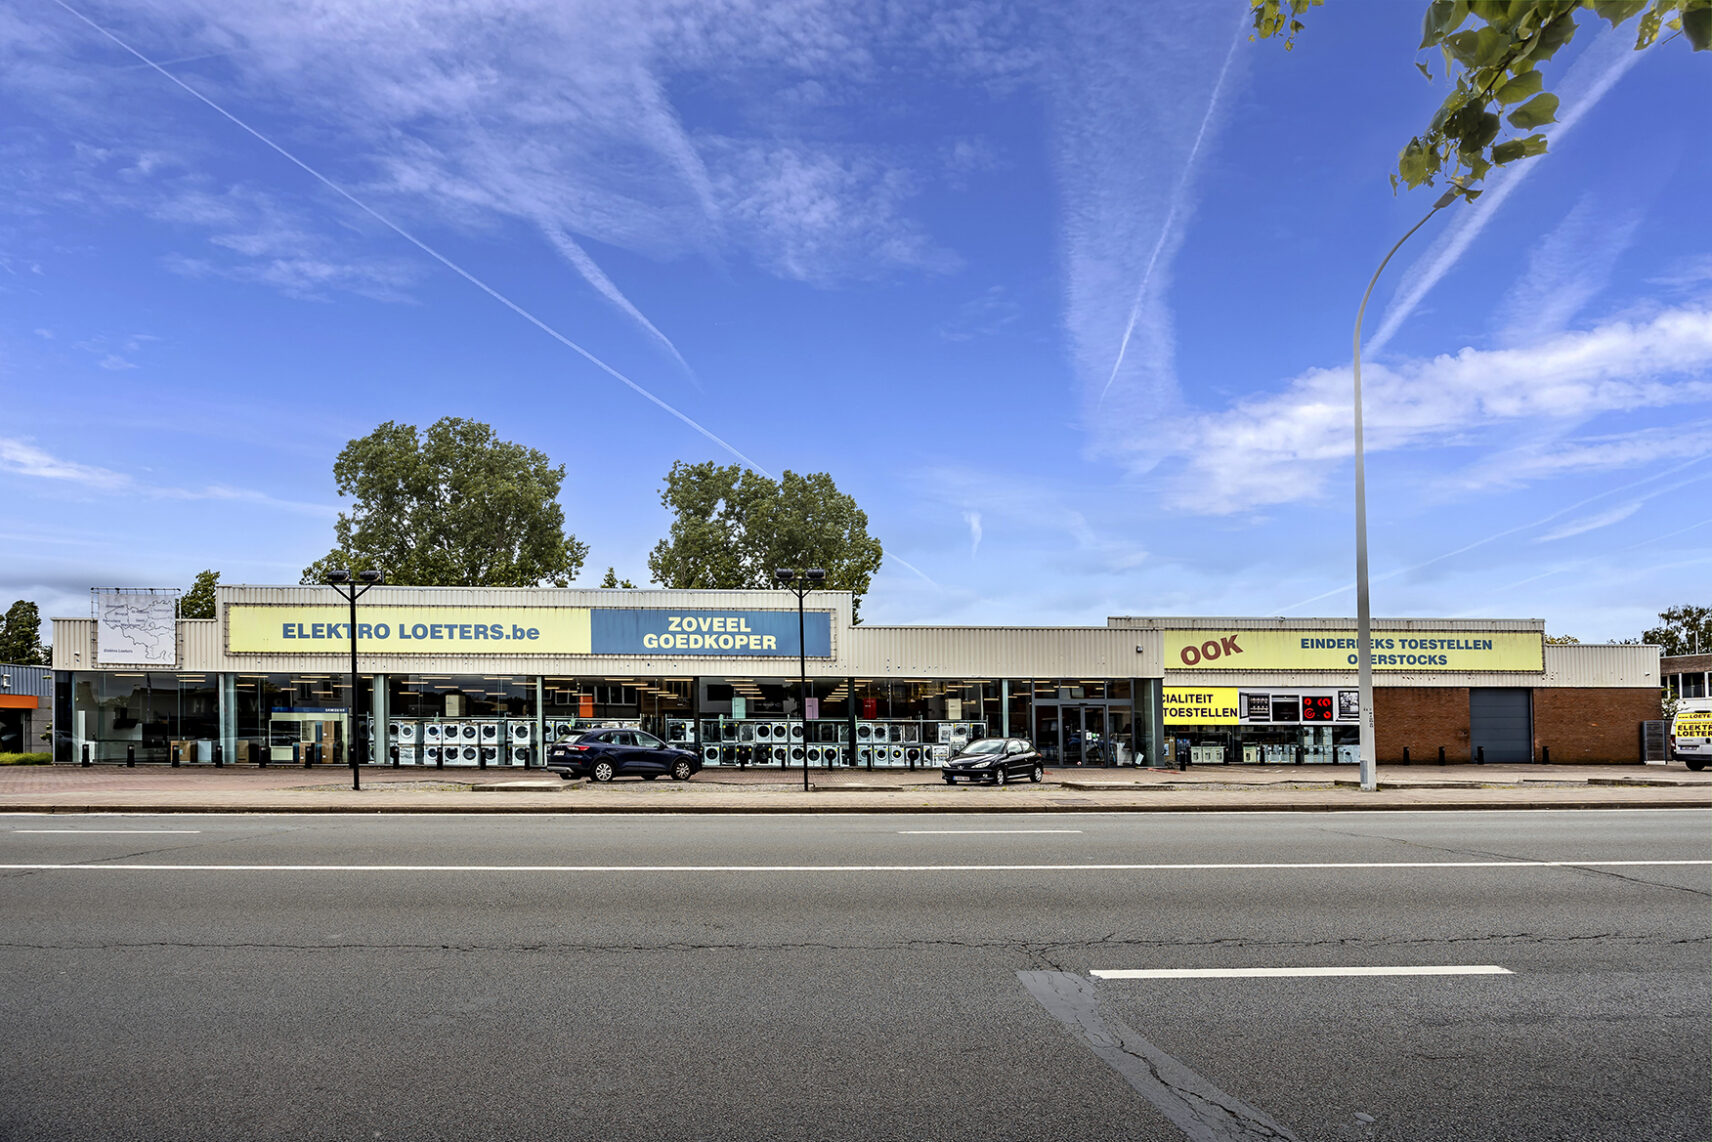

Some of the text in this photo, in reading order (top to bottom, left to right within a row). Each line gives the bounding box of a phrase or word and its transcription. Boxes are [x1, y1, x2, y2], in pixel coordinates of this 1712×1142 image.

[282, 623, 540, 640] ELEKTRO LOETERS.be
[668, 617, 751, 632] ZOVEEL
[643, 634, 777, 650] GOEDKOPER
[1300, 638, 1492, 650] EINDERKS TOESTELLEN
[1180, 634, 1243, 666] OOK
[1347, 654, 1448, 666] OERSTOCKS
[1163, 708, 1238, 717] TOESTELLEN
